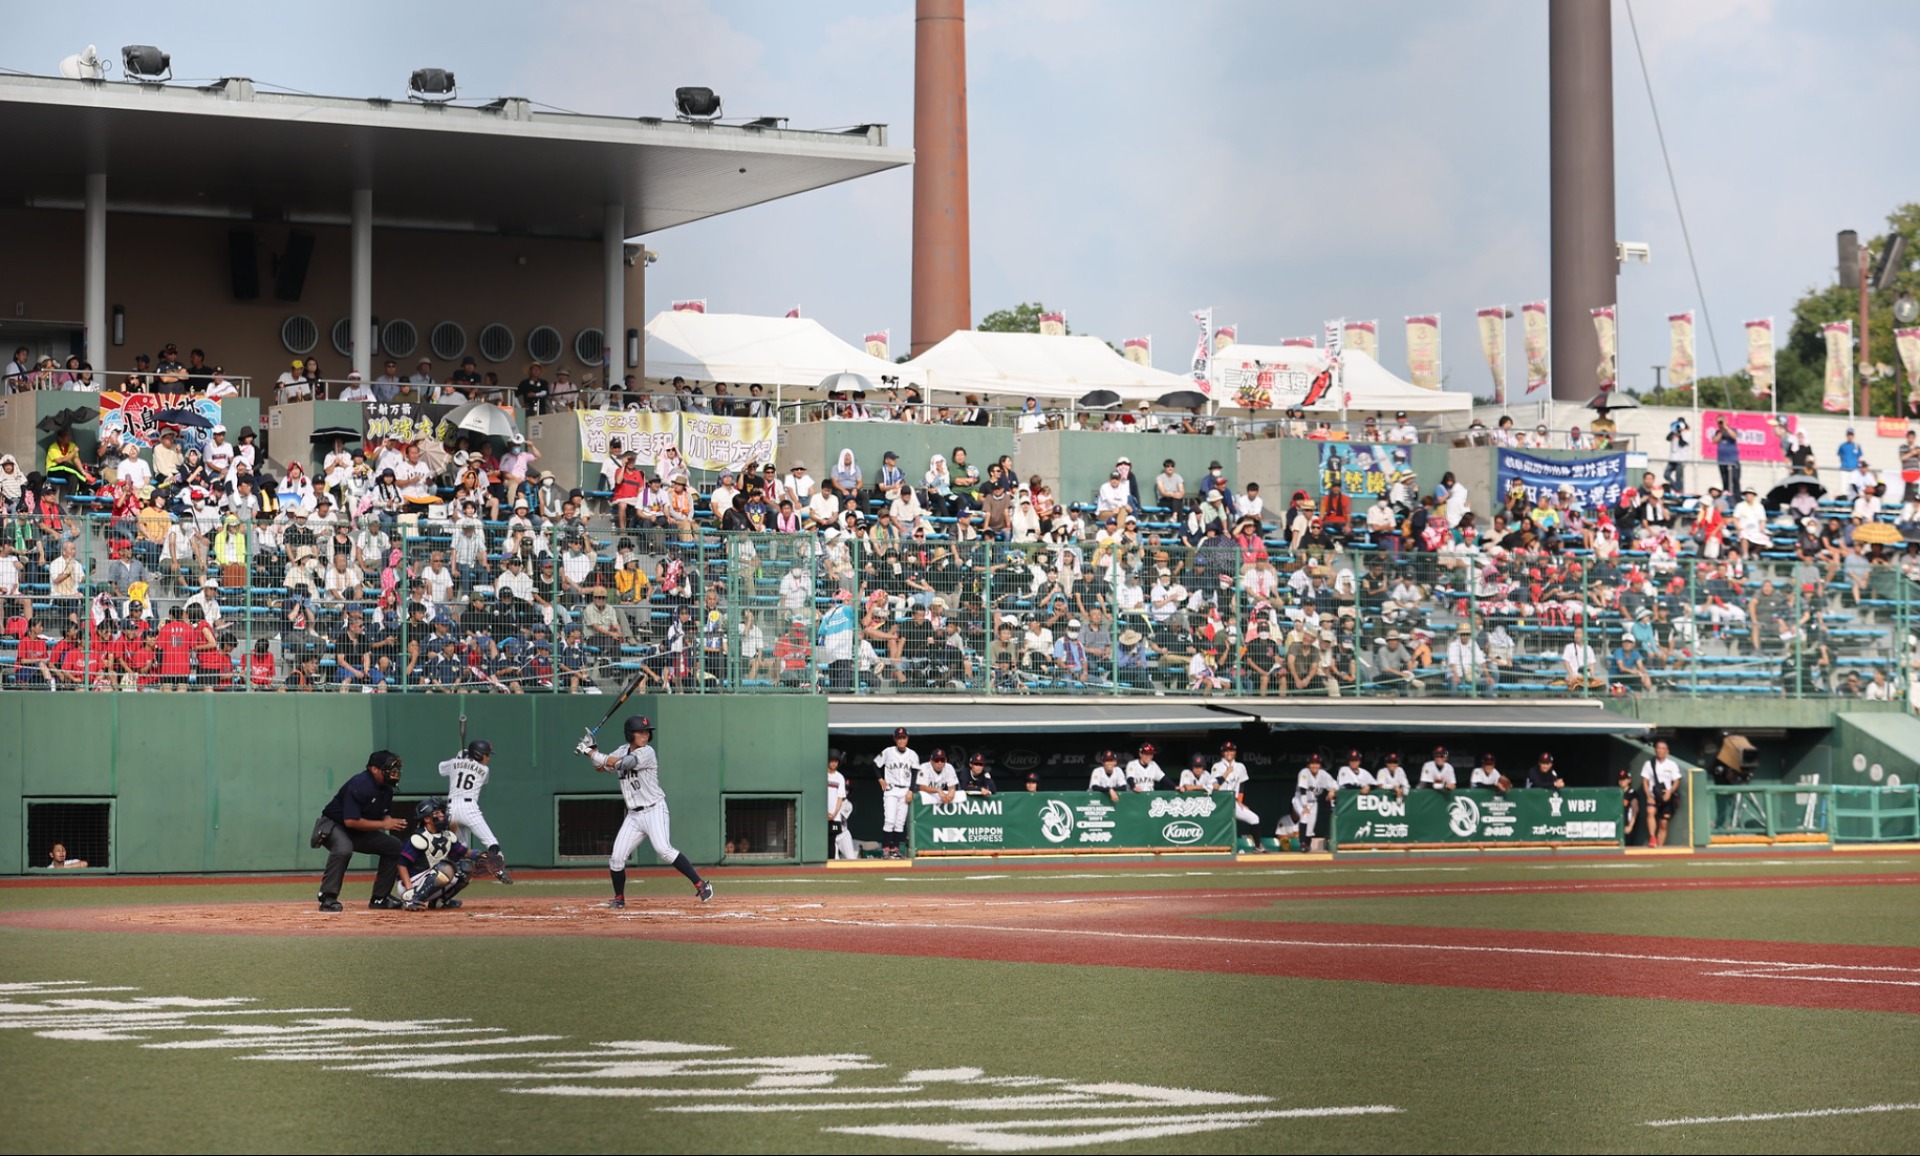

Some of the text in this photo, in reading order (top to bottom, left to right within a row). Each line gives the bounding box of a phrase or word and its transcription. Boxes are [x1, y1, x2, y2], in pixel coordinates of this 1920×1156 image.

[584, 413, 640, 428] やってみる
[689, 434, 772, 463] 川端友紀
[456, 771, 476, 791] 16
[630, 780, 642, 791] 10
[932, 800, 1003, 816] KONAMI
[1148, 797, 1218, 818] カーネクスト
[1357, 794, 1406, 817] EDION
[1567, 799, 1597, 813] WBFJ
[968, 827, 1003, 835] NIPPON
[1166, 824, 1202, 838] Kowa
[1374, 823, 1409, 837] 三次市
[968, 835, 1003, 843] EXPRESS
